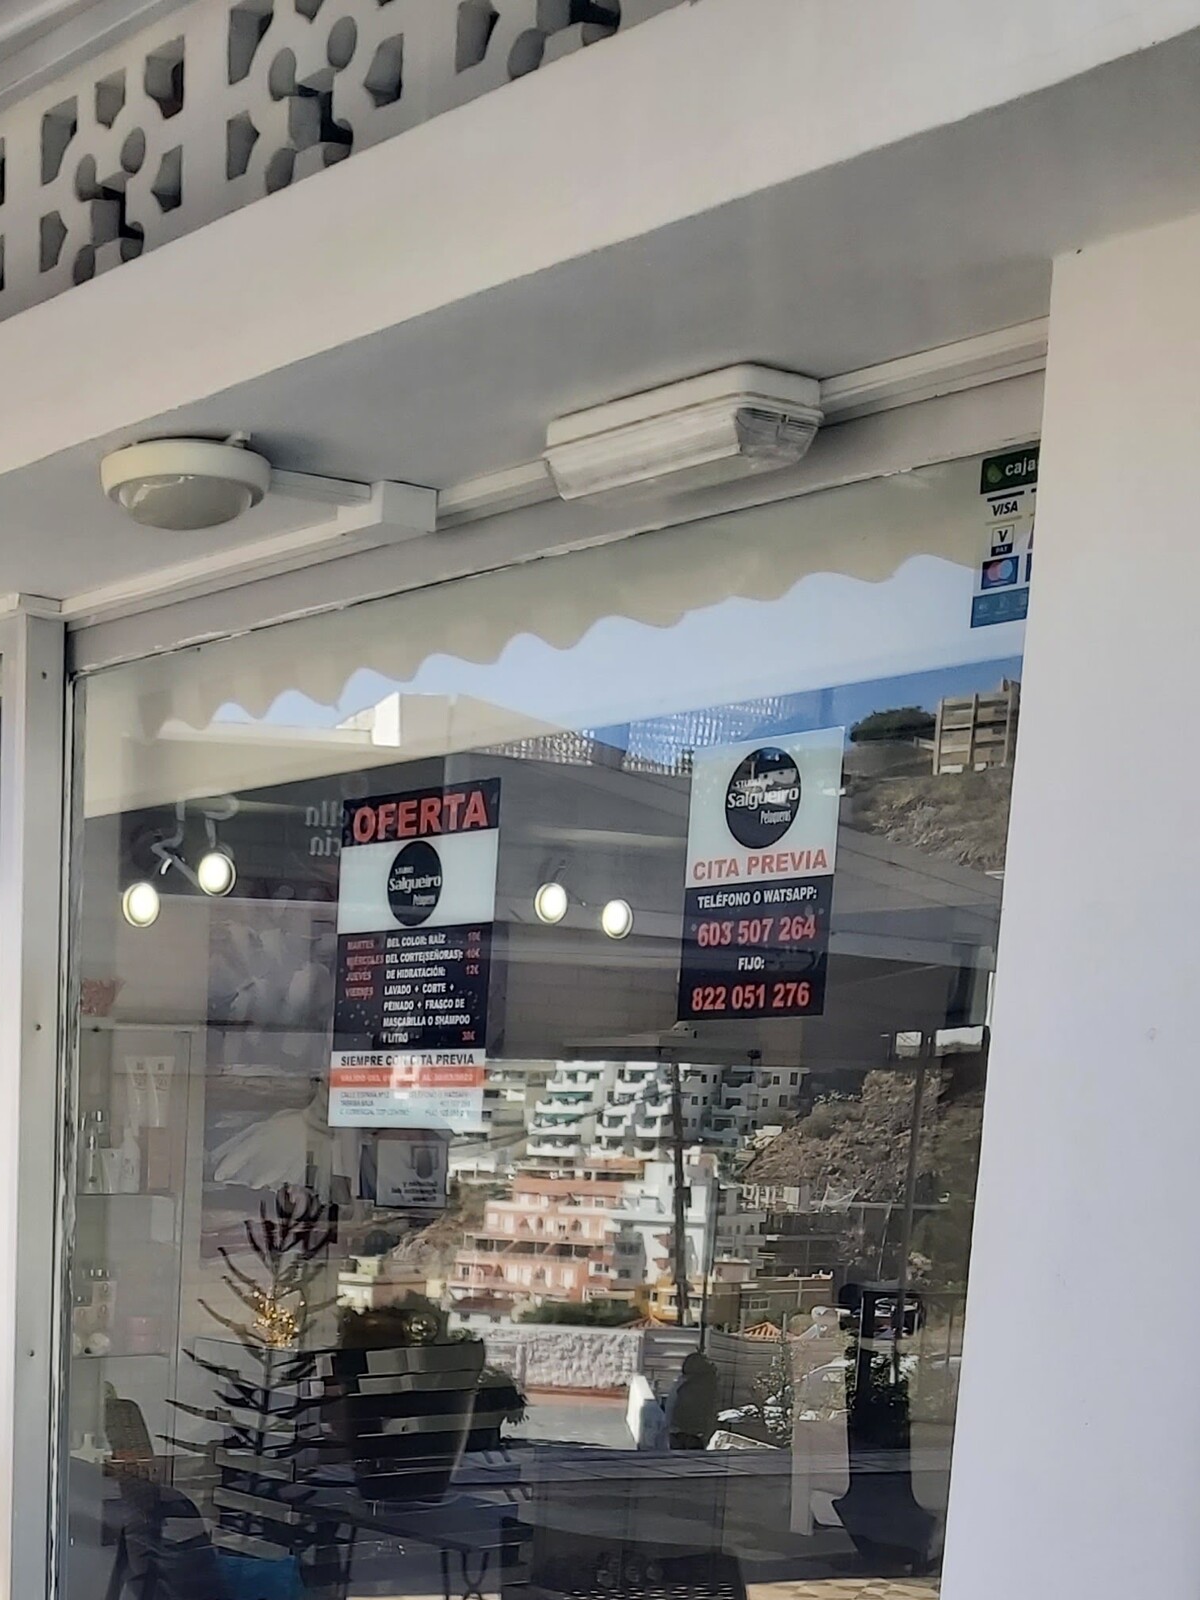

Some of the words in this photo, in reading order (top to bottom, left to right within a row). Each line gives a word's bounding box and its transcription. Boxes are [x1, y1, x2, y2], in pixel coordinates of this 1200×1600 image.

[1005, 456, 1039, 477] caja
[992, 501, 1018, 516] VISA
[727, 787, 799, 809] Salgueiro
[352, 790, 489, 843] OFERTA
[693, 858, 739, 881] CITA
[747, 848, 827, 876] PREVIA
[388, 874, 442, 894] Salgueiro
[698, 891, 750, 908] TELÉFONO
[753, 892, 761, 904] O
[764, 886, 817, 902] WATSAPP:
[697, 921, 733, 947] 603
[737, 918, 774, 944] 507
[778, 914, 816, 941] 264
[387, 936, 400, 948] DEL
[385, 953, 399, 964] DEL
[738, 956, 765, 970] FIJO:
[386, 969, 396, 980] DE
[384, 985, 411, 996] LAVADO
[422, 983, 446, 994] CORTE
[692, 986, 726, 1011] 822
[732, 984, 765, 1008] 051
[772, 981, 810, 1007] 276
[384, 1001, 414, 1012] PEINADO
[425, 999, 453, 1010] FRASCO
[455, 998, 465, 1008] DE
[383, 1016, 426, 1027] MASCARILLA
[427, 1016, 434, 1026] O
[388, 1032, 408, 1043] LITRO
[341, 1055, 383, 1067] SIEMPRE
[436, 1053, 474, 1065] PREVIA
